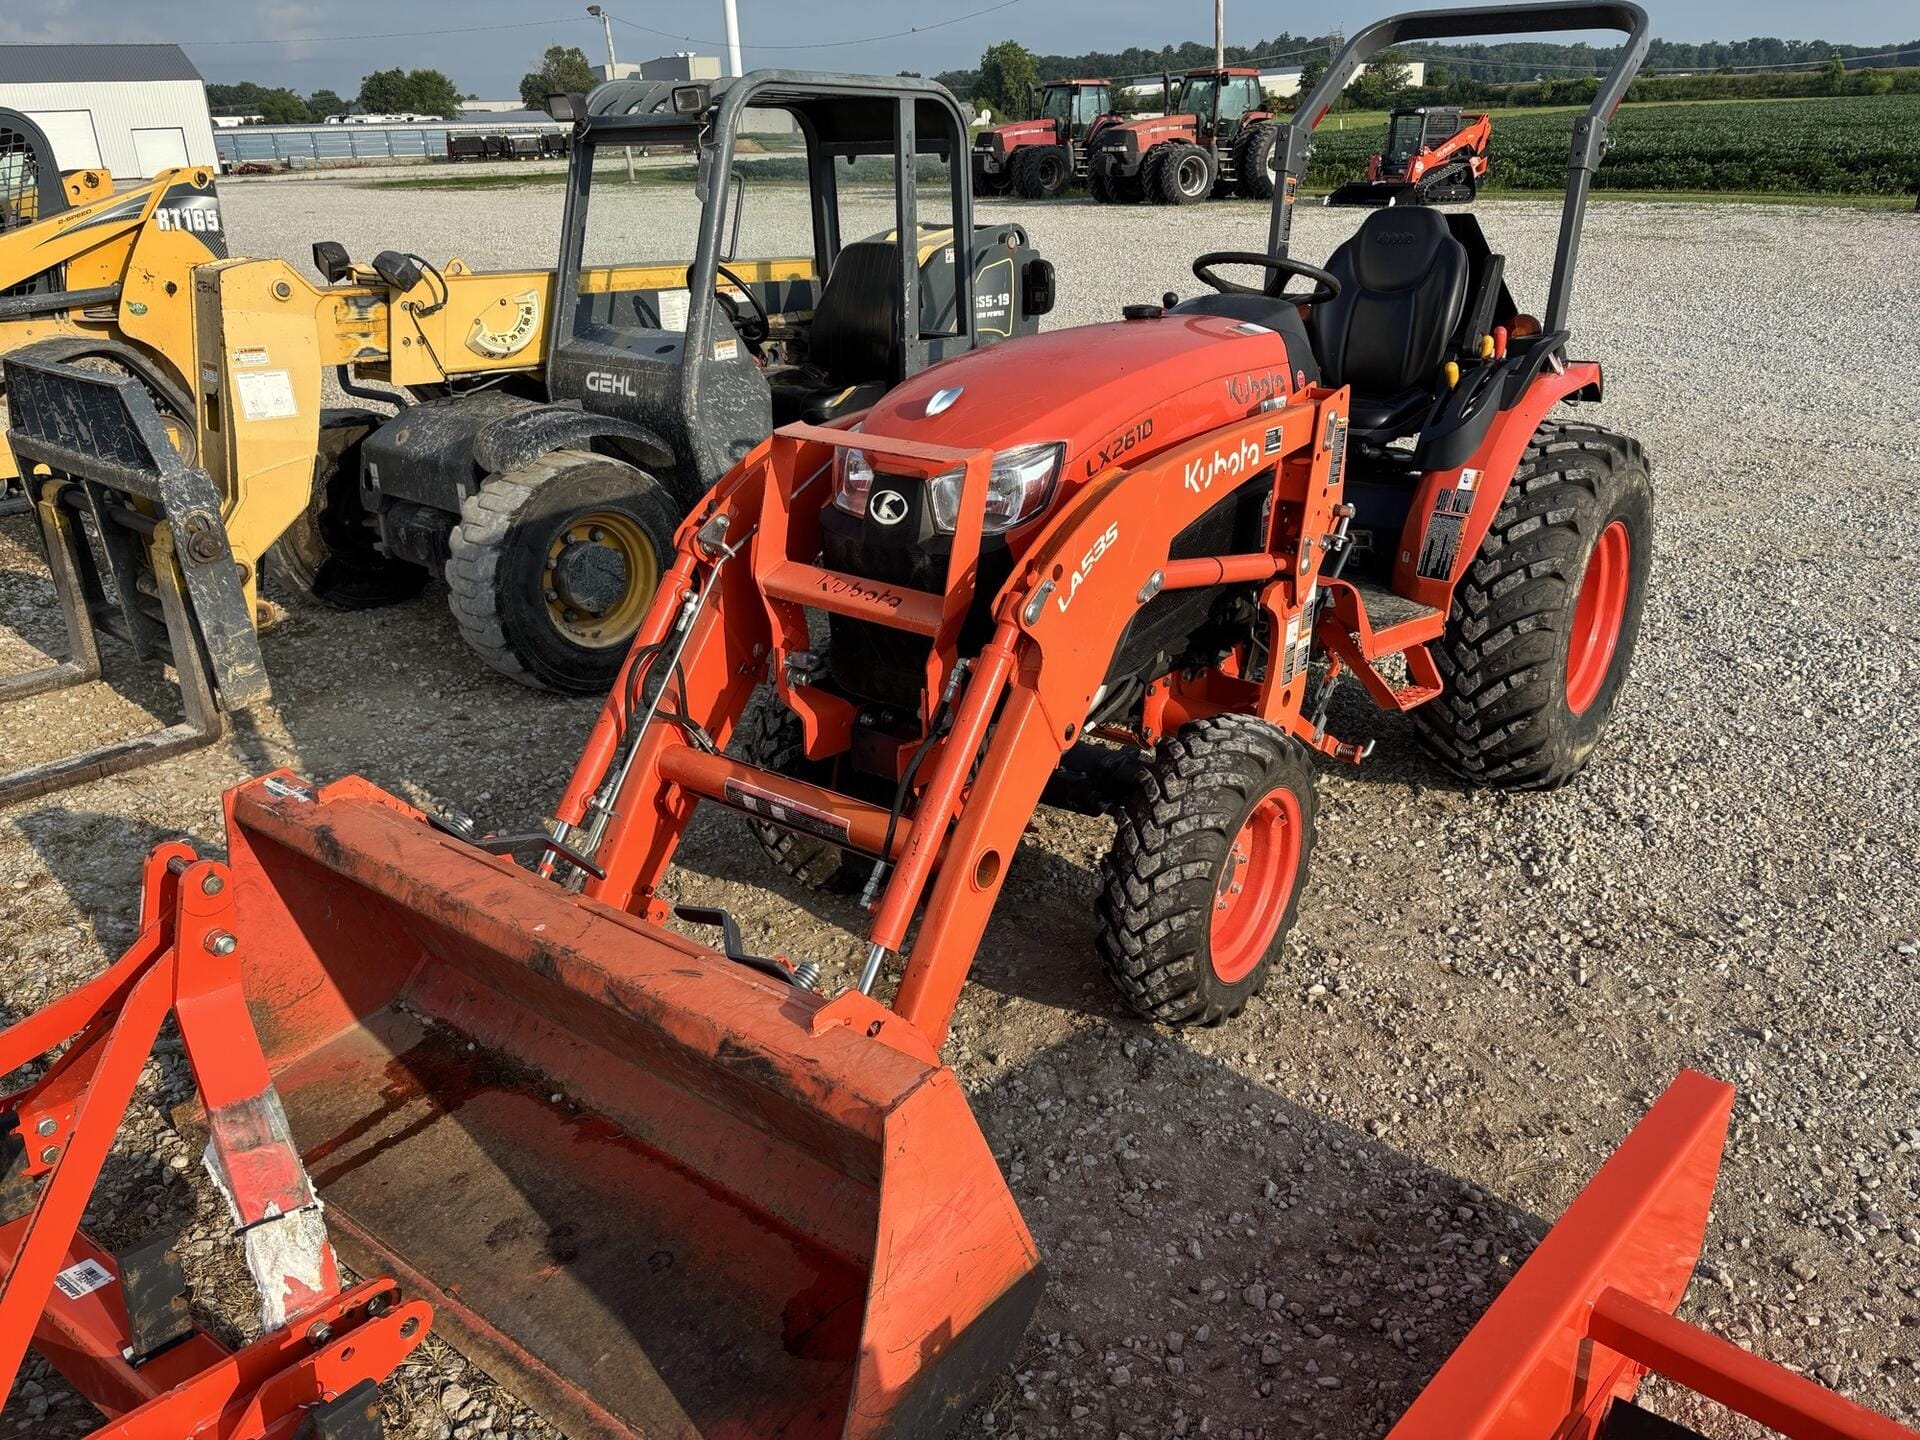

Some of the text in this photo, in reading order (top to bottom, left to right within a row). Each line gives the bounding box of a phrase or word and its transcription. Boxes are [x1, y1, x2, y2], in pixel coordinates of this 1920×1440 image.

[155, 207, 219, 232] RT165
[585, 371, 637, 397] GEHL
[1225, 370, 1286, 405] Kubota
[1184, 438, 1260, 494] Kubota
[1057, 520, 1119, 613] LA535
[816, 573, 903, 608] Kubota
